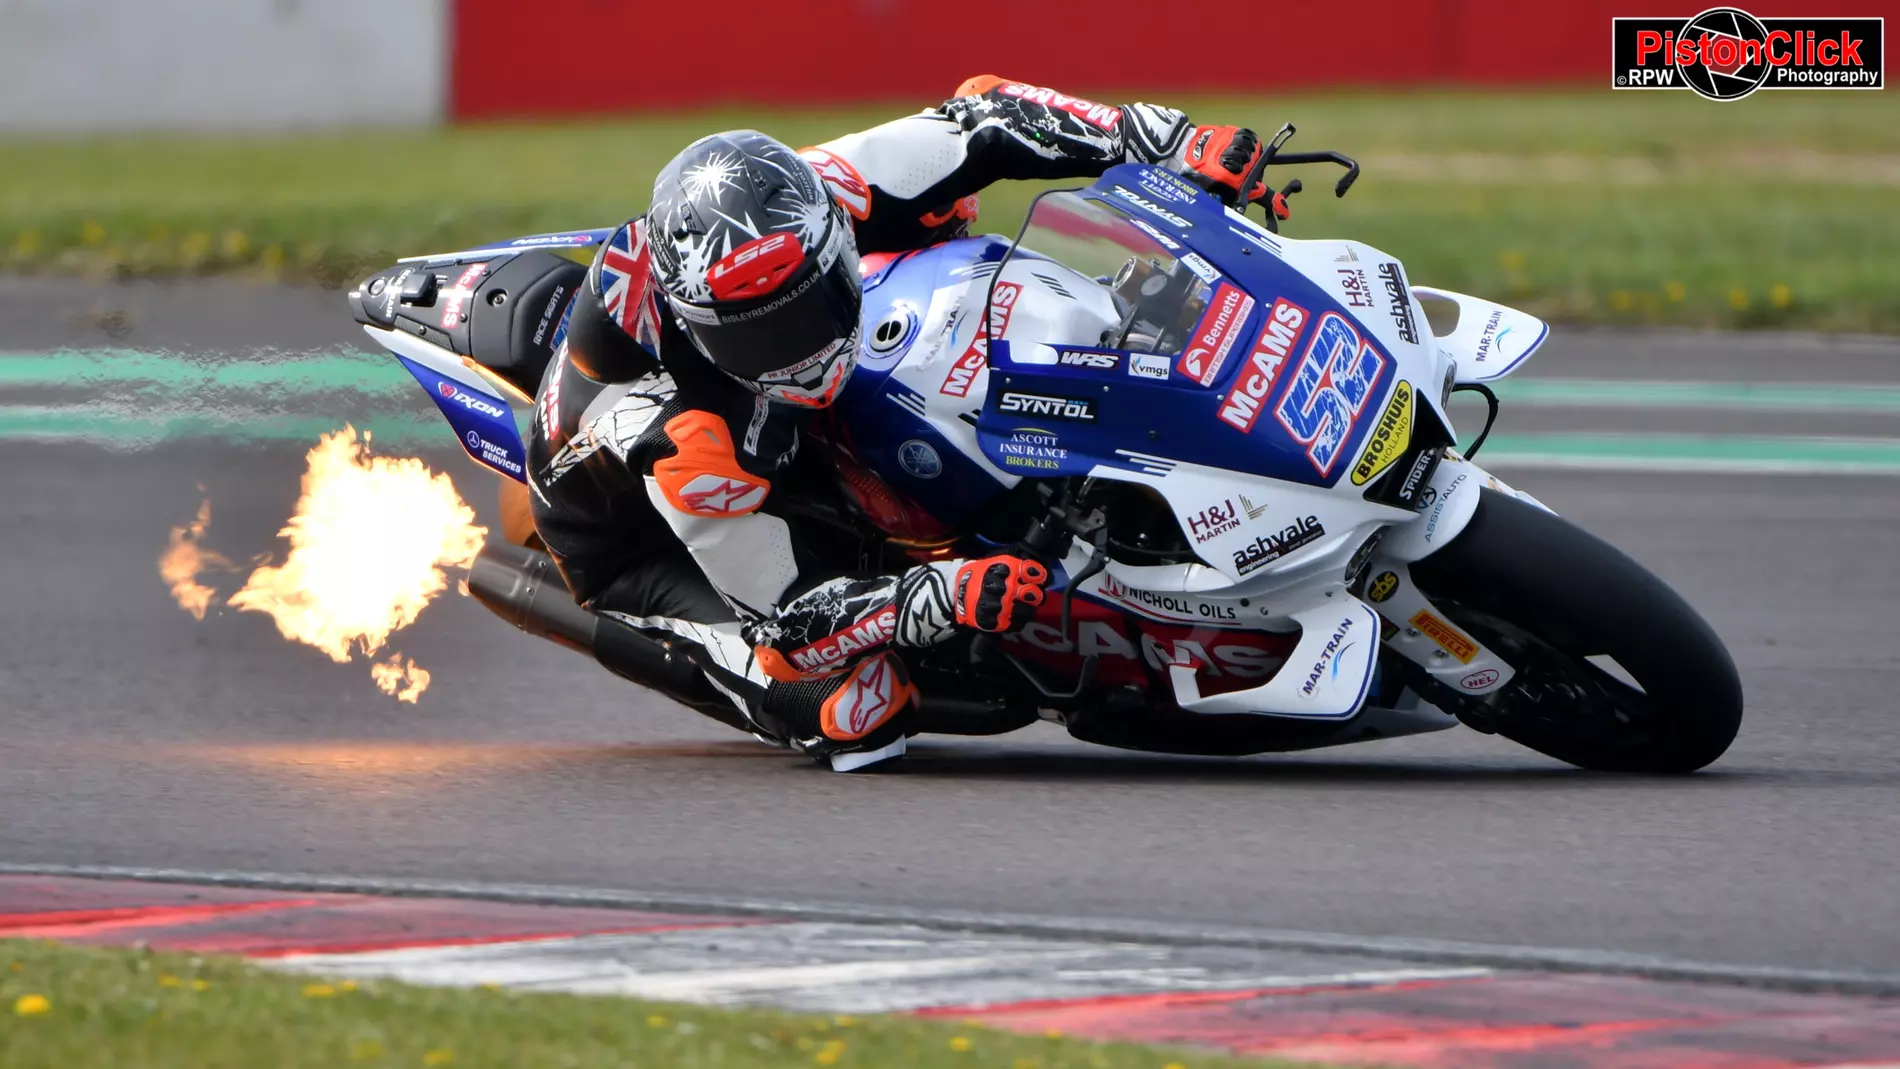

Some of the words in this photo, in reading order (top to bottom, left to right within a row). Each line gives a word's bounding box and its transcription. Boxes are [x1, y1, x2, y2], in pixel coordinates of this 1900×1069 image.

[1004, 84, 1119, 127] McAMS
[1139, 169, 1197, 204] INSURANCE
[1152, 168, 1198, 196] BROKERS
[1114, 185, 1193, 228] SYNTOL
[714, 234, 785, 279] LS2
[721, 270, 821, 324] BISLEYREMOVALS.CO.UK
[1337, 269, 1366, 307] H&J
[1356, 269, 1375, 308] MARTIN
[533, 317, 549, 345] RACE
[545, 285, 564, 318] SEATS
[1202, 290, 1241, 347] Bennetts
[1475, 310, 1503, 362] MAR-TRAIN
[780, 361, 808, 377] JUNIOR
[808, 343, 836, 365] LIMITED
[1138, 363, 1168, 377] vmgs
[1221, 303, 1304, 429] McAMS
[1000, 392, 1094, 419] SYNTOL
[1273, 311, 1387, 478] 52
[480, 439, 508, 458] TRUCK
[1000, 443, 1067, 459] INSURANCE
[1010, 433, 1058, 446] ASCOTT
[1356, 387, 1410, 479] BROSHUIS
[1381, 416, 1409, 463] HOLLAND
[482, 450, 522, 474] SERVICES
[1005, 455, 1059, 469] BROKERS
[1399, 449, 1431, 500] SPIDER
[1187, 499, 1236, 536] H&J
[1424, 474, 1468, 543] ASSISTAUTO
[1196, 518, 1241, 544] MARTIN
[1239, 550, 1280, 574] engineering
[1128, 588, 1193, 615] NICHOLL
[1199, 603, 1236, 619] OILS
[793, 611, 897, 669] McAMS
[1416, 613, 1475, 659] PIRELLI
[1302, 617, 1354, 696] MAR-TRAIN
[1468, 675, 1495, 688] HEL
